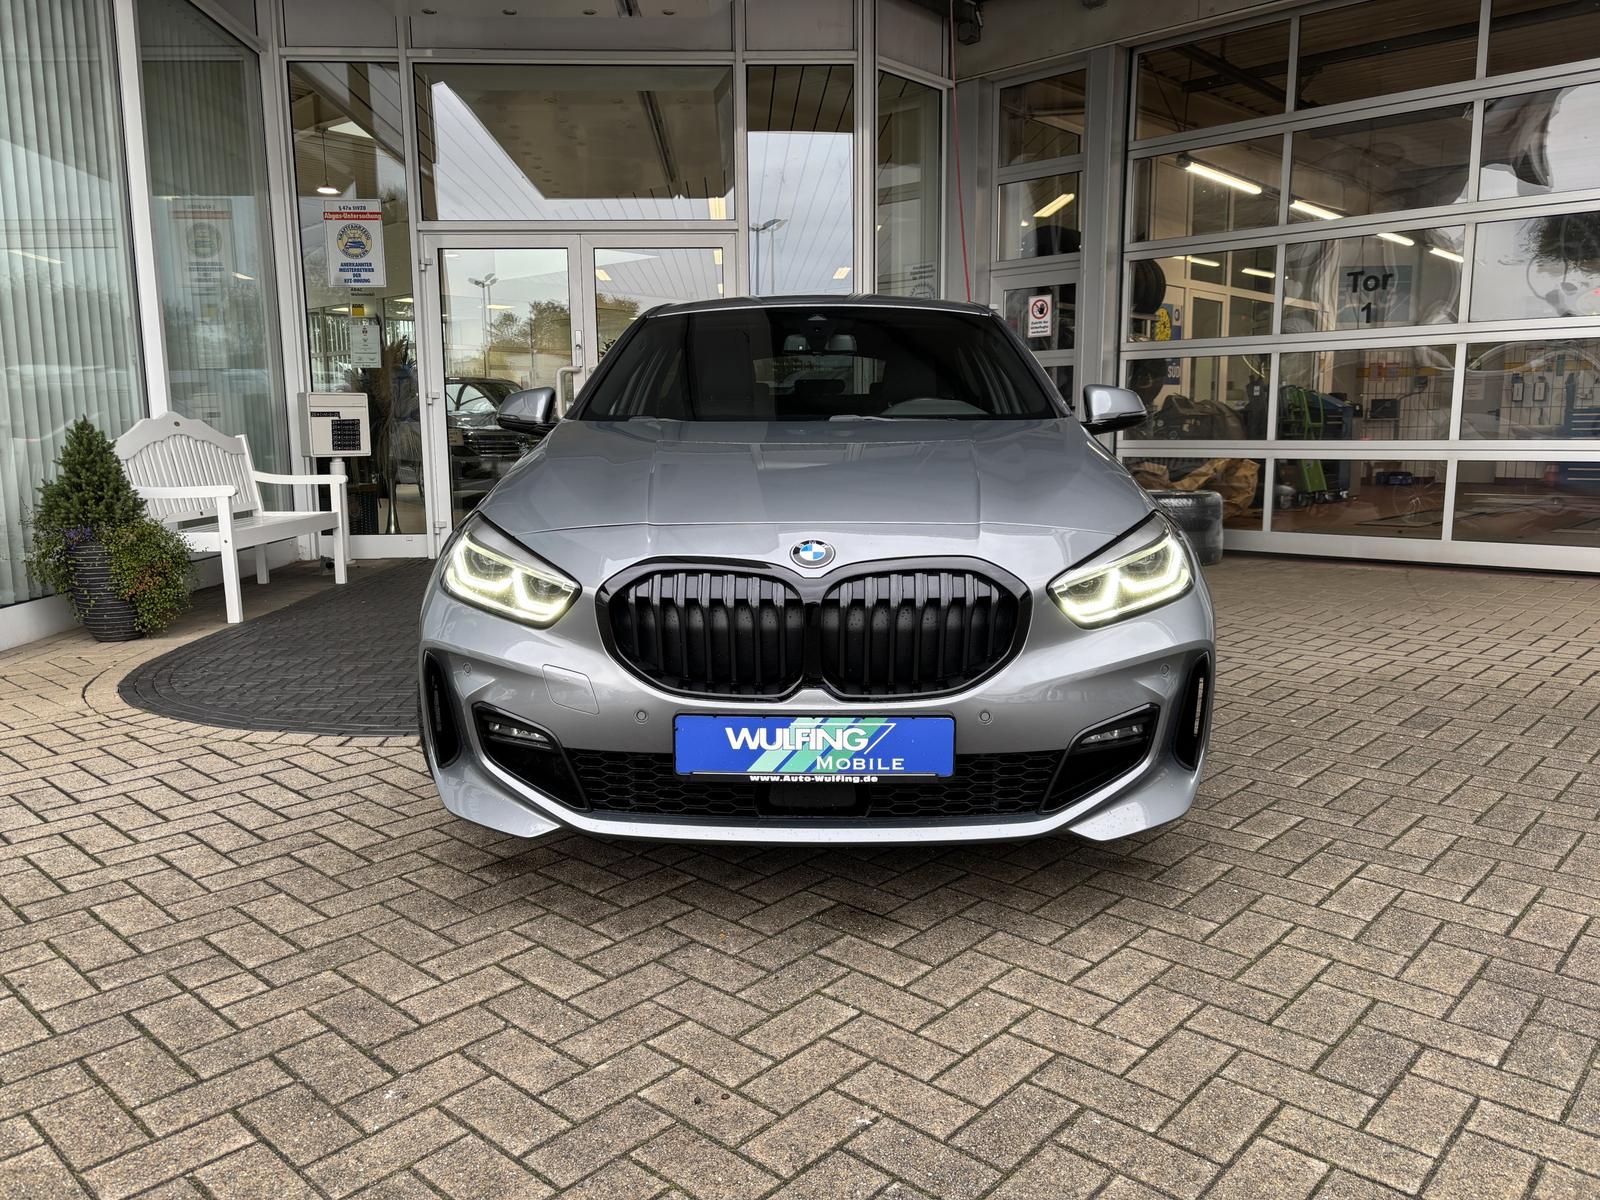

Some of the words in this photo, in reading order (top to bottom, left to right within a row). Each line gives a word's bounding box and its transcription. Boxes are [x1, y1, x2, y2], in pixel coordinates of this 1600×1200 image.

[1346, 270, 1394, 293] Tor
[1360, 302, 1372, 324] 1
[816, 756, 904, 770] MOBILE
[749, 775, 878, 783] www.Auto-Wulfing.de
